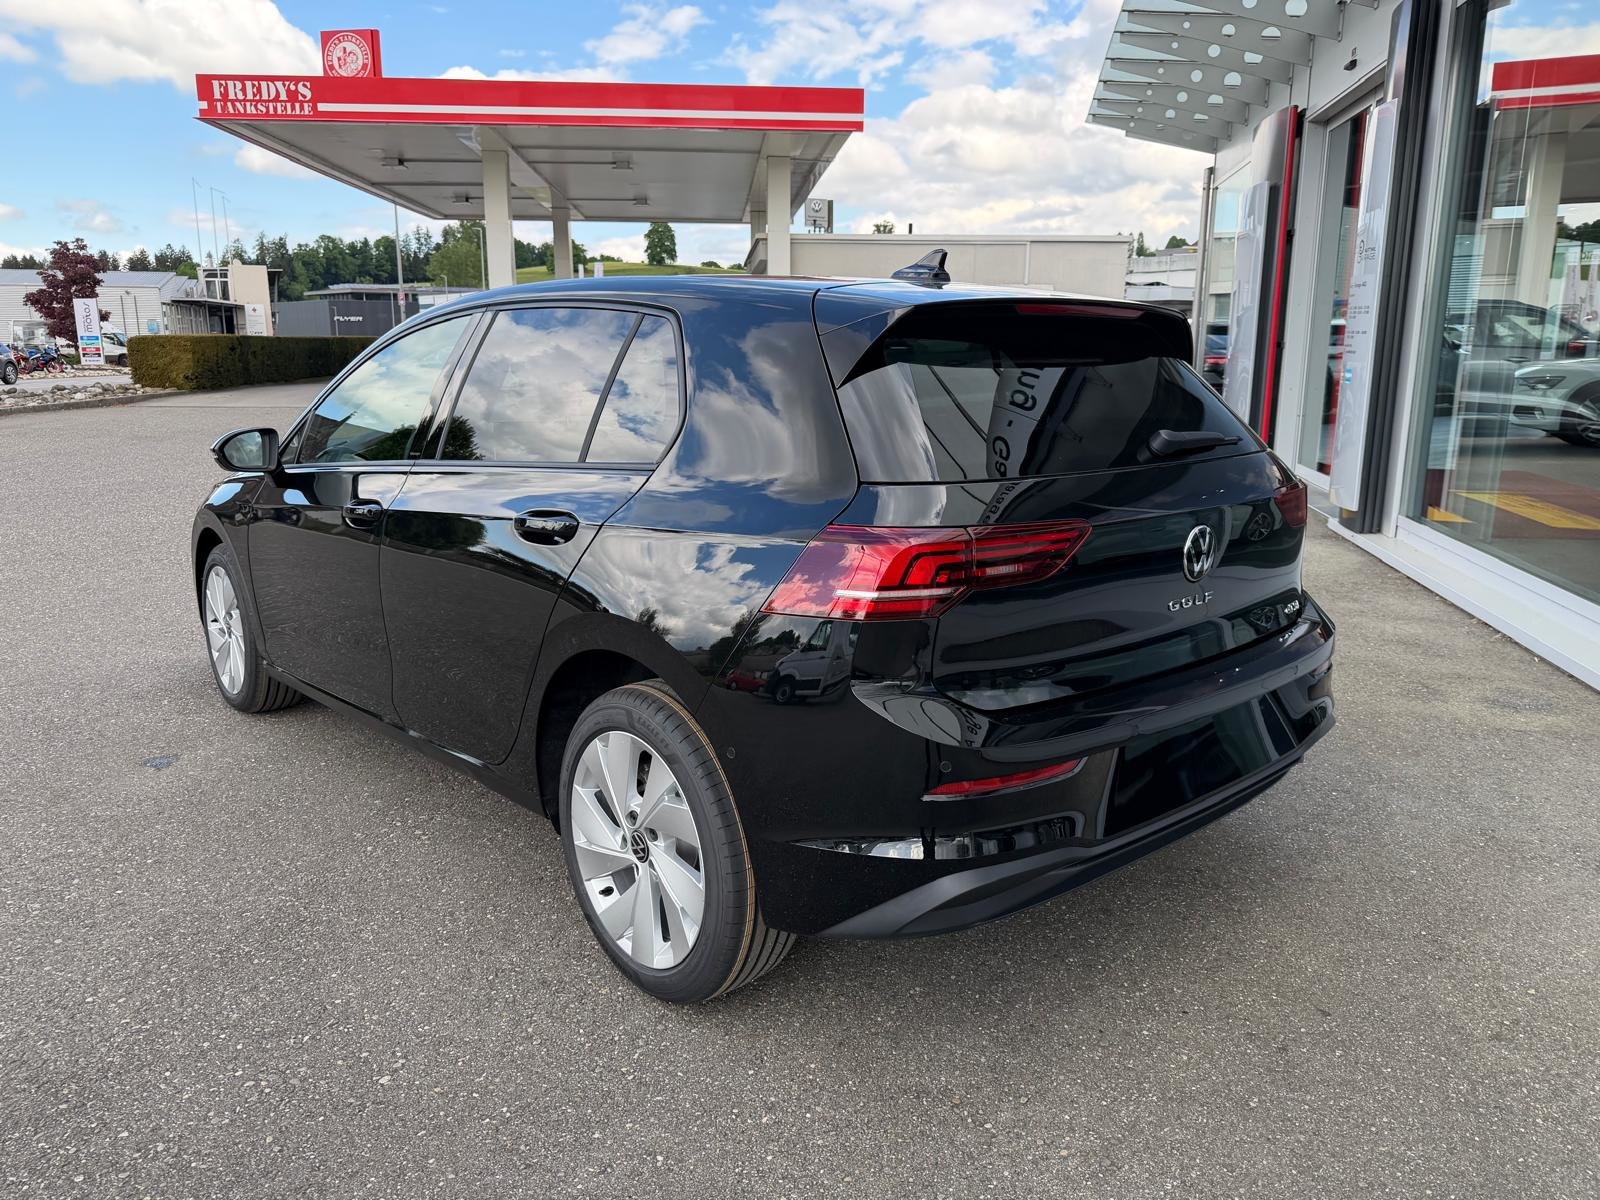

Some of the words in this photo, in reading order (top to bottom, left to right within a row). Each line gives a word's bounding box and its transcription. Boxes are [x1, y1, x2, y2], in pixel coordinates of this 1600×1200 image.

[212, 80, 312, 101] FREDY'S
[214, 101, 313, 115] TANKSTELLE
[1168, 591, 1214, 611] GOLF
